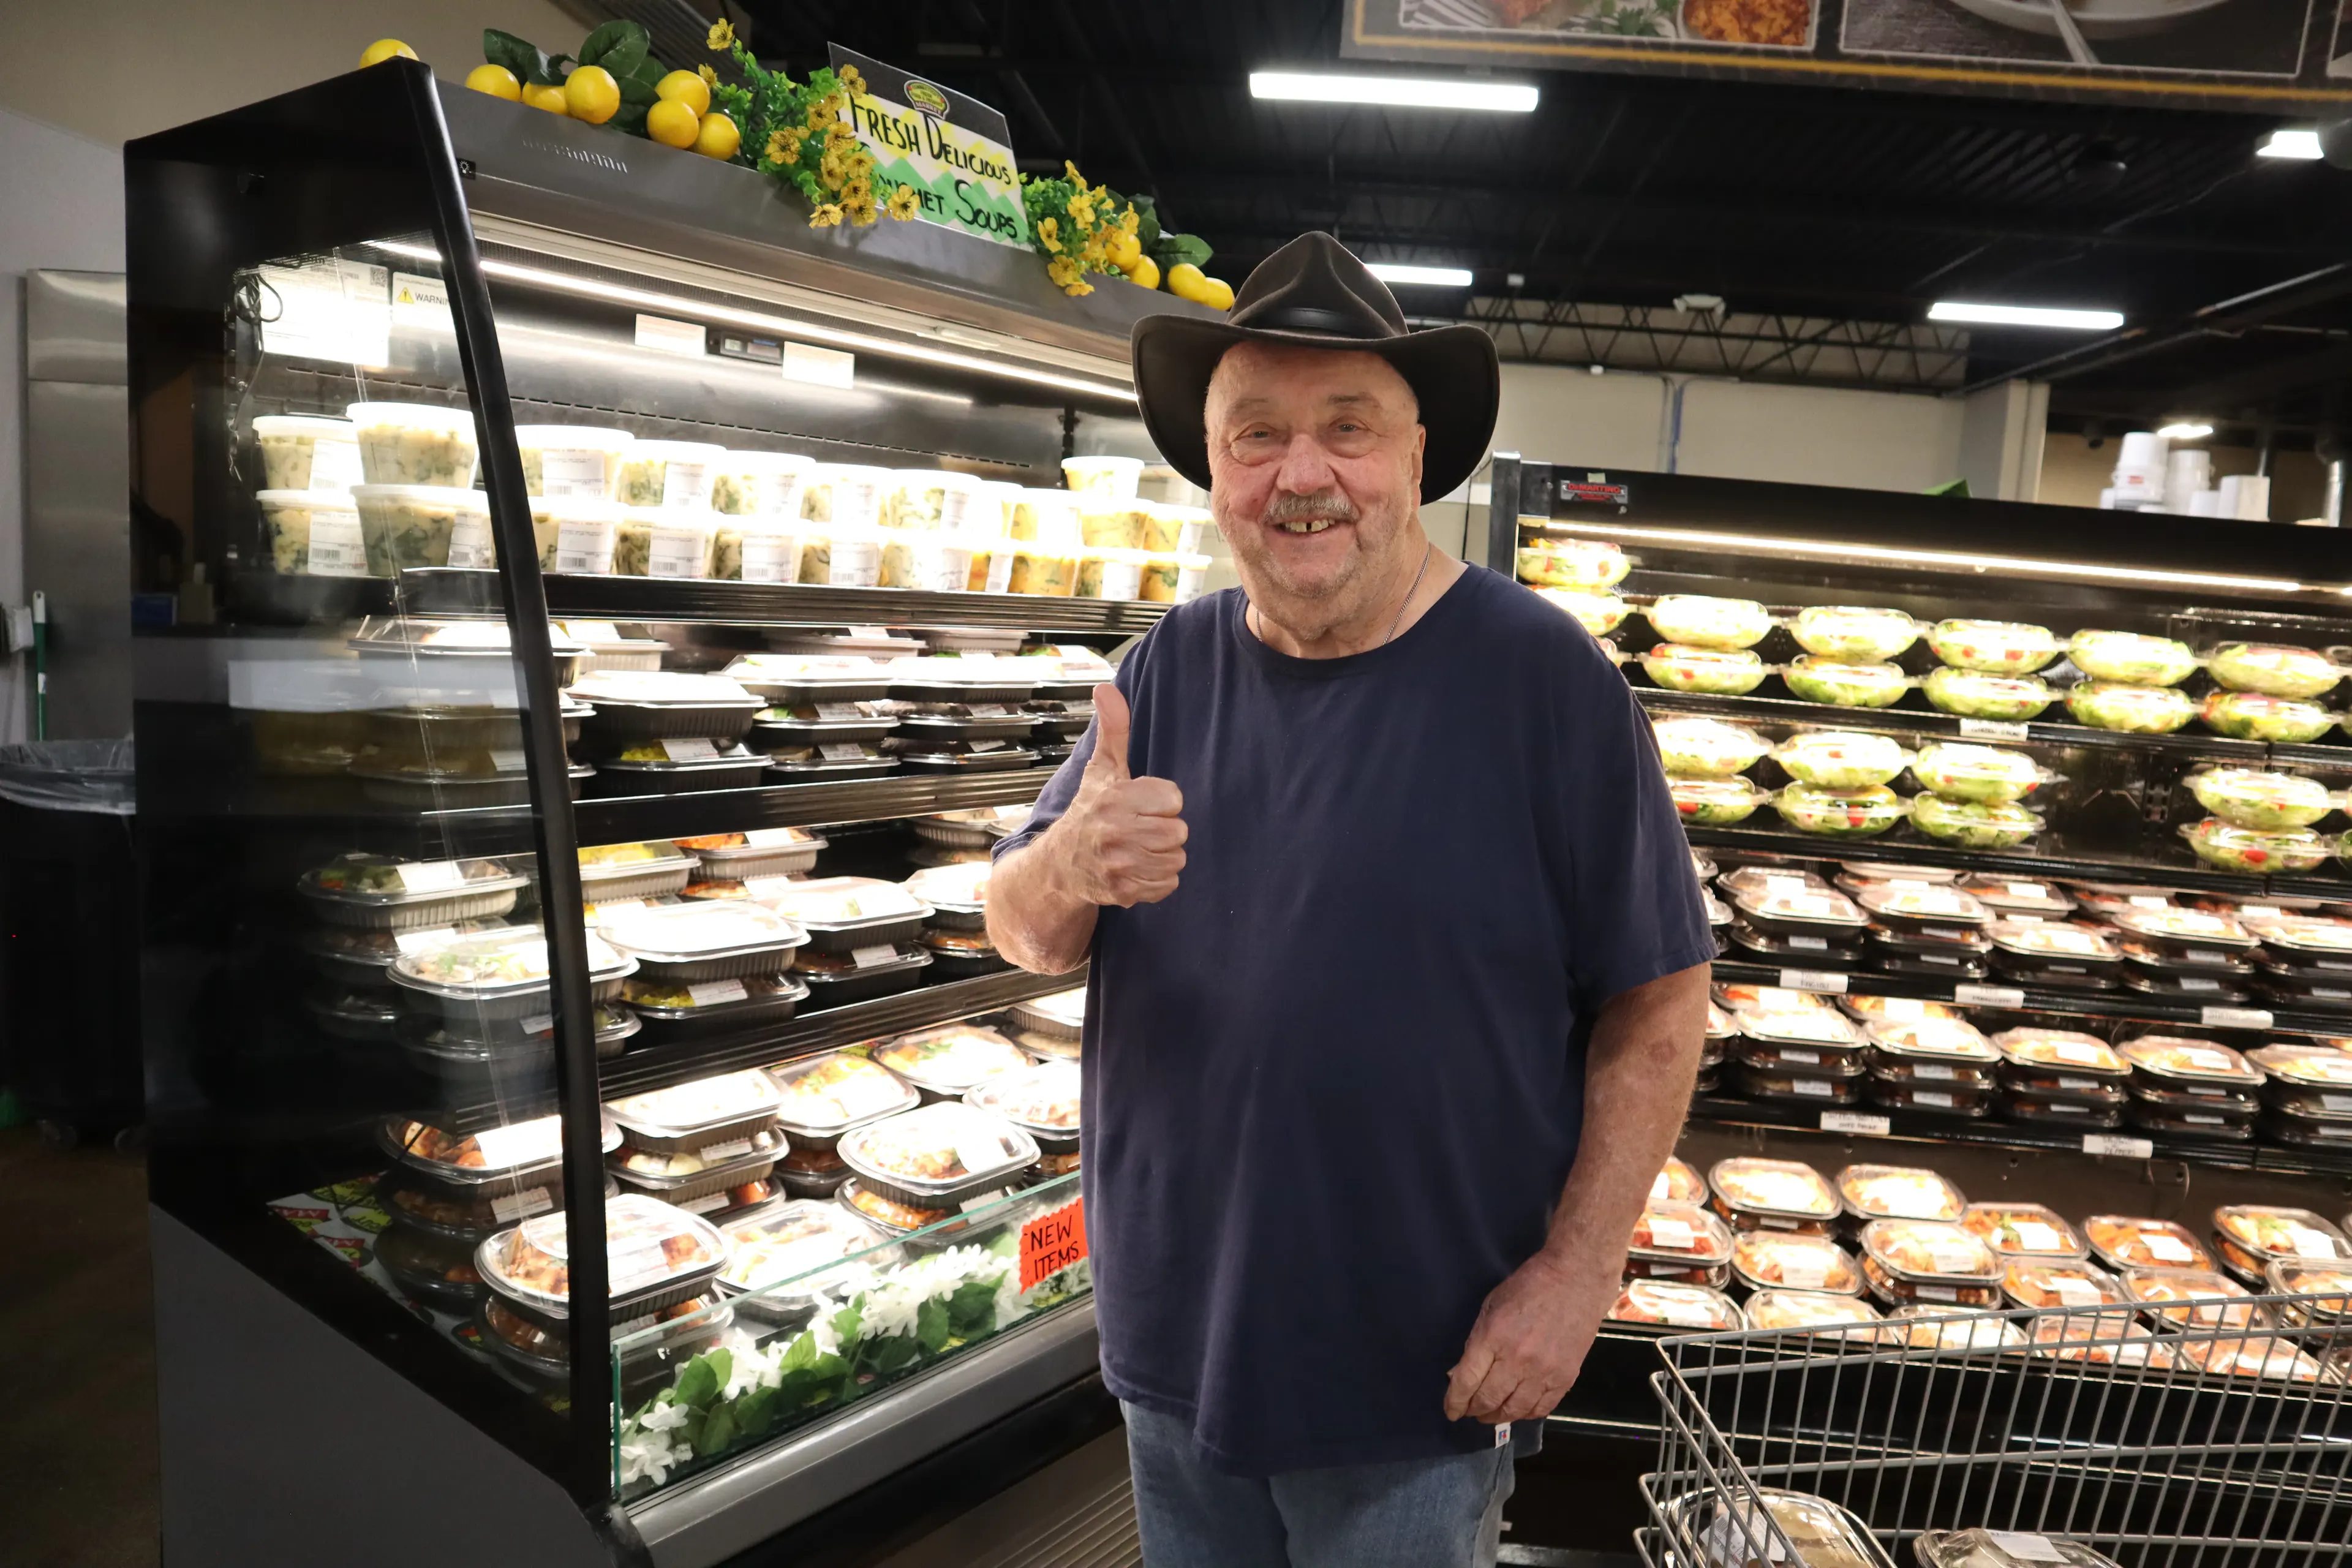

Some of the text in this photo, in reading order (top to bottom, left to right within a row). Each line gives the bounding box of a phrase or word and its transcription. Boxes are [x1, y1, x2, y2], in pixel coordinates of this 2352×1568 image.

[849, 91, 921, 156] FRESH
[954, 179, 1017, 238] SOUPS
[415, 292, 449, 306] WARNIN
[1031, 1215, 1072, 1251] NEW
[1035, 1241, 1079, 1280] ITEMS
